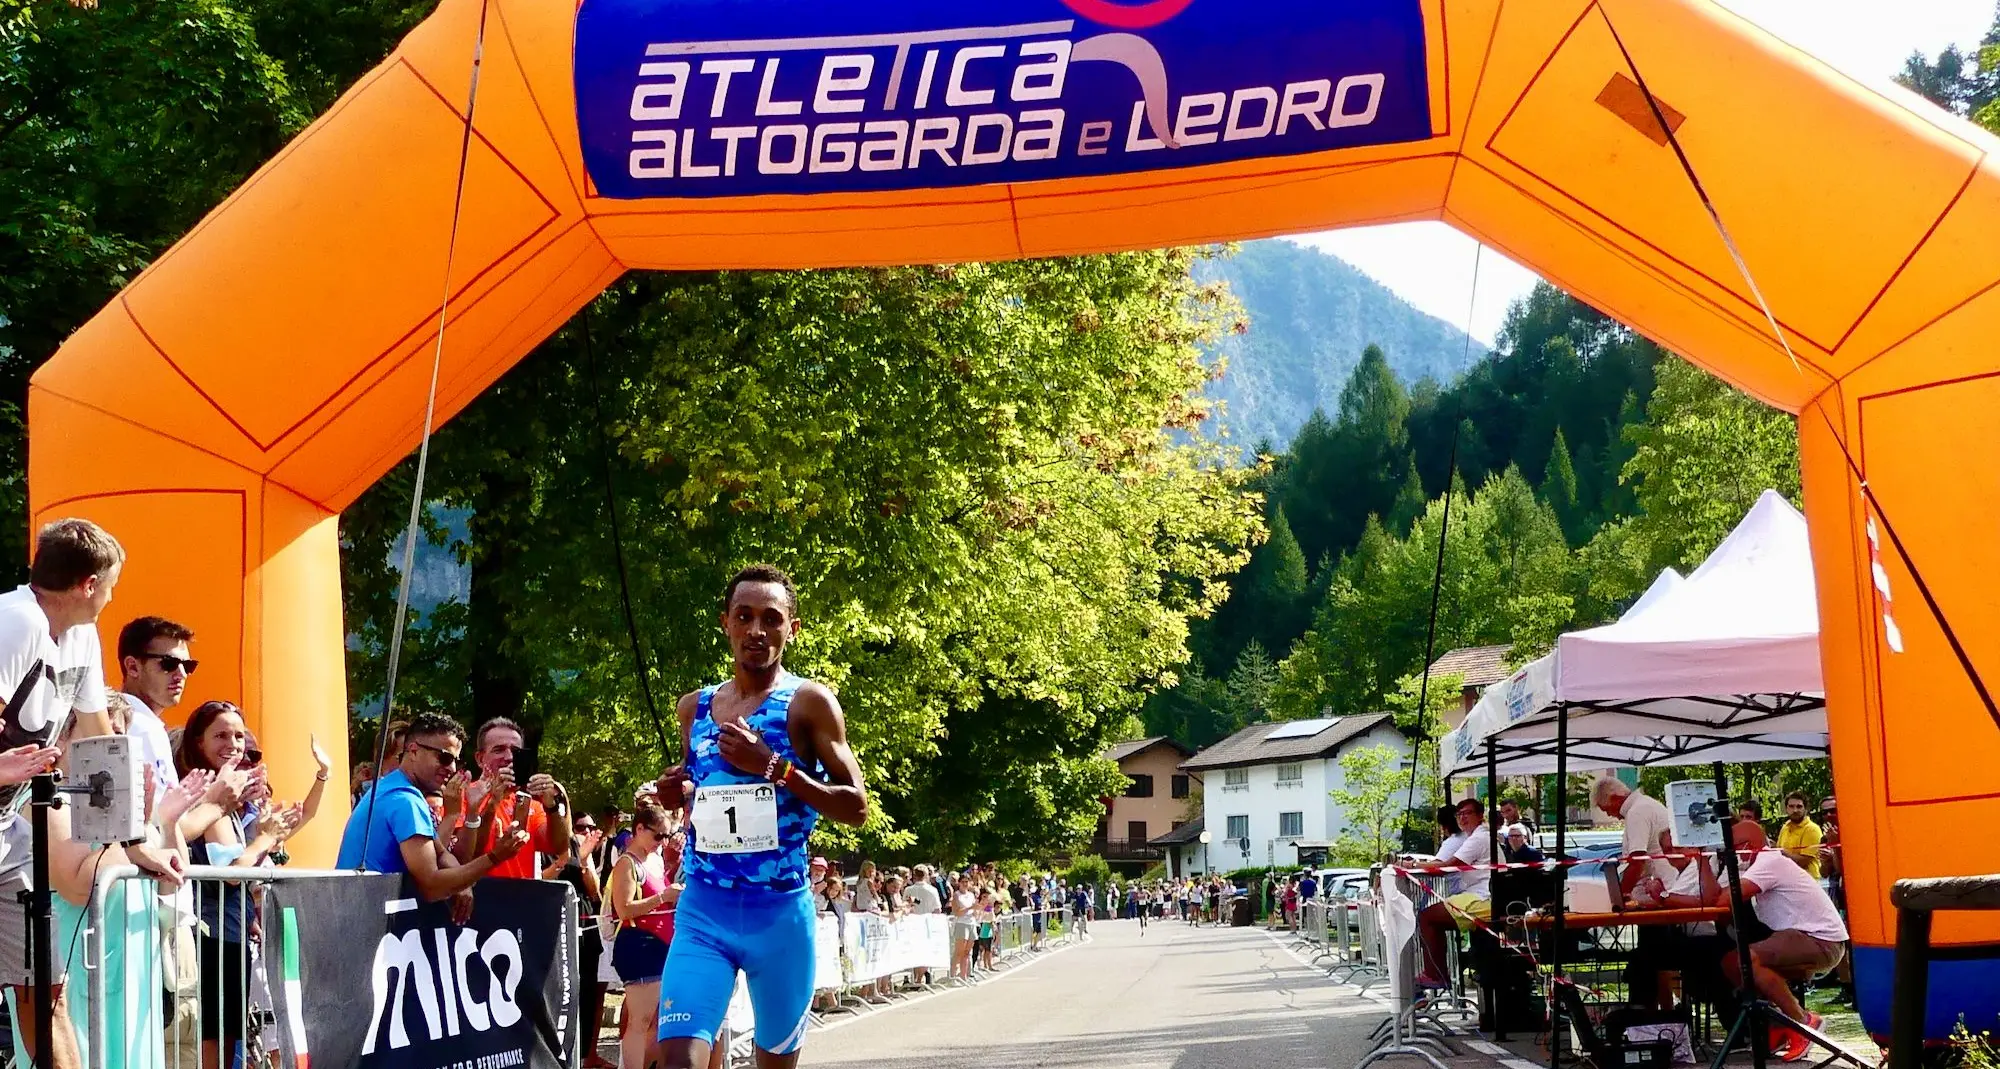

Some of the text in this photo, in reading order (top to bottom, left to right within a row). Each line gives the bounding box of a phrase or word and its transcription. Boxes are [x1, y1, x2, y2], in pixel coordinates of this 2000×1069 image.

[1077, 121, 1112, 156] e
[724, 807, 737, 834] 1
[362, 927, 523, 1055] MICO
[476, 1048, 525, 1069] PERFORMANCE
